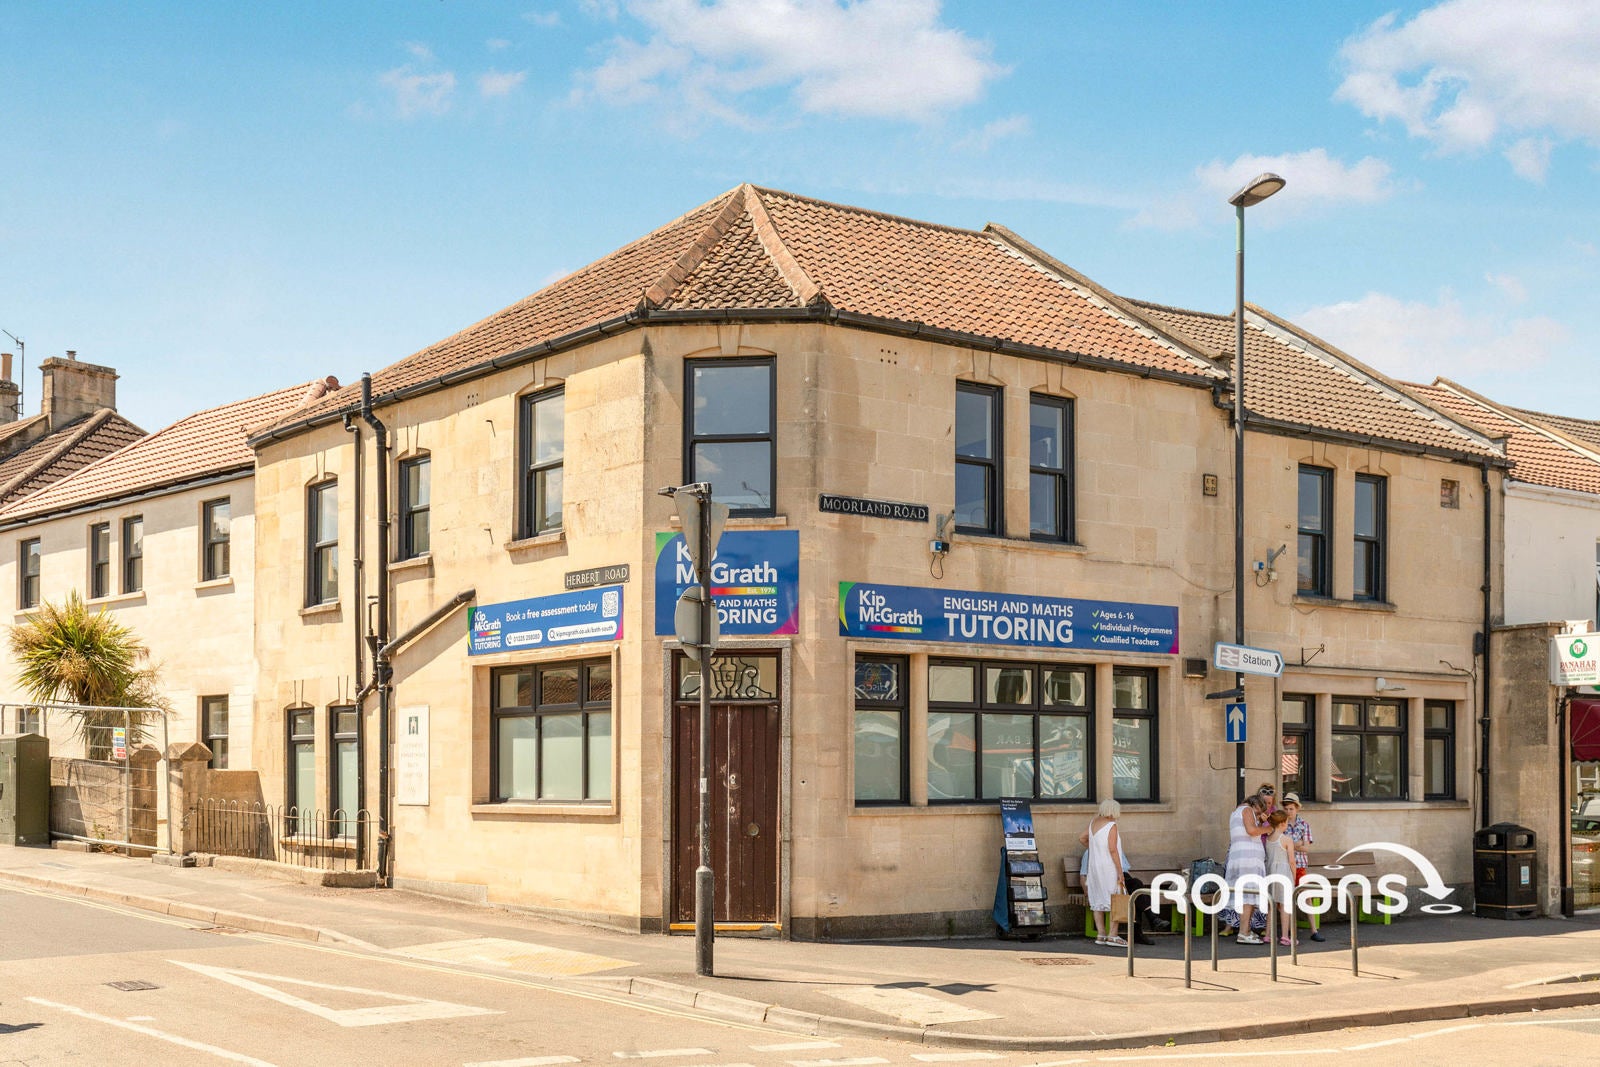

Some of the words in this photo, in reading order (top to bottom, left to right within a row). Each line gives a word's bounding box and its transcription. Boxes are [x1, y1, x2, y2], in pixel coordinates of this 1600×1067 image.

[822, 498, 891, 516] MOORLAND
[894, 505, 926, 519] ROAD
[566, 571, 600, 586] HERBERT
[604, 567, 628, 580] ROAD
[676, 561, 777, 584] MGrath
[719, 599, 741, 608] AND
[743, 598, 778, 608] MATHS
[859, 589, 886, 611] Kip
[943, 597, 998, 613] ENGLISH
[1001, 601, 1029, 615] AND
[1032, 603, 1074, 618] MATHS
[474, 611, 486, 624] Kip
[506, 611, 521, 622] Book
[527, 609, 540, 619] free
[541, 604, 578, 617] assessment
[579, 602, 598, 613] today
[718, 608, 778, 625] ORING
[859, 606, 923, 625] McGrath
[1099, 611, 1117, 620] Ages
[474, 618, 501, 632] McGrath
[943, 613, 1074, 643] TUTORING
[1099, 622, 1131, 633] Individual
[1133, 624, 1173, 636] Programmes
[475, 640, 501, 651] TUTORING
[1099, 635, 1130, 645] Qualified
[1131, 637, 1160, 646] Teachers
[1242, 653, 1272, 667] Station
[1559, 660, 1597, 669] PANAHAR
